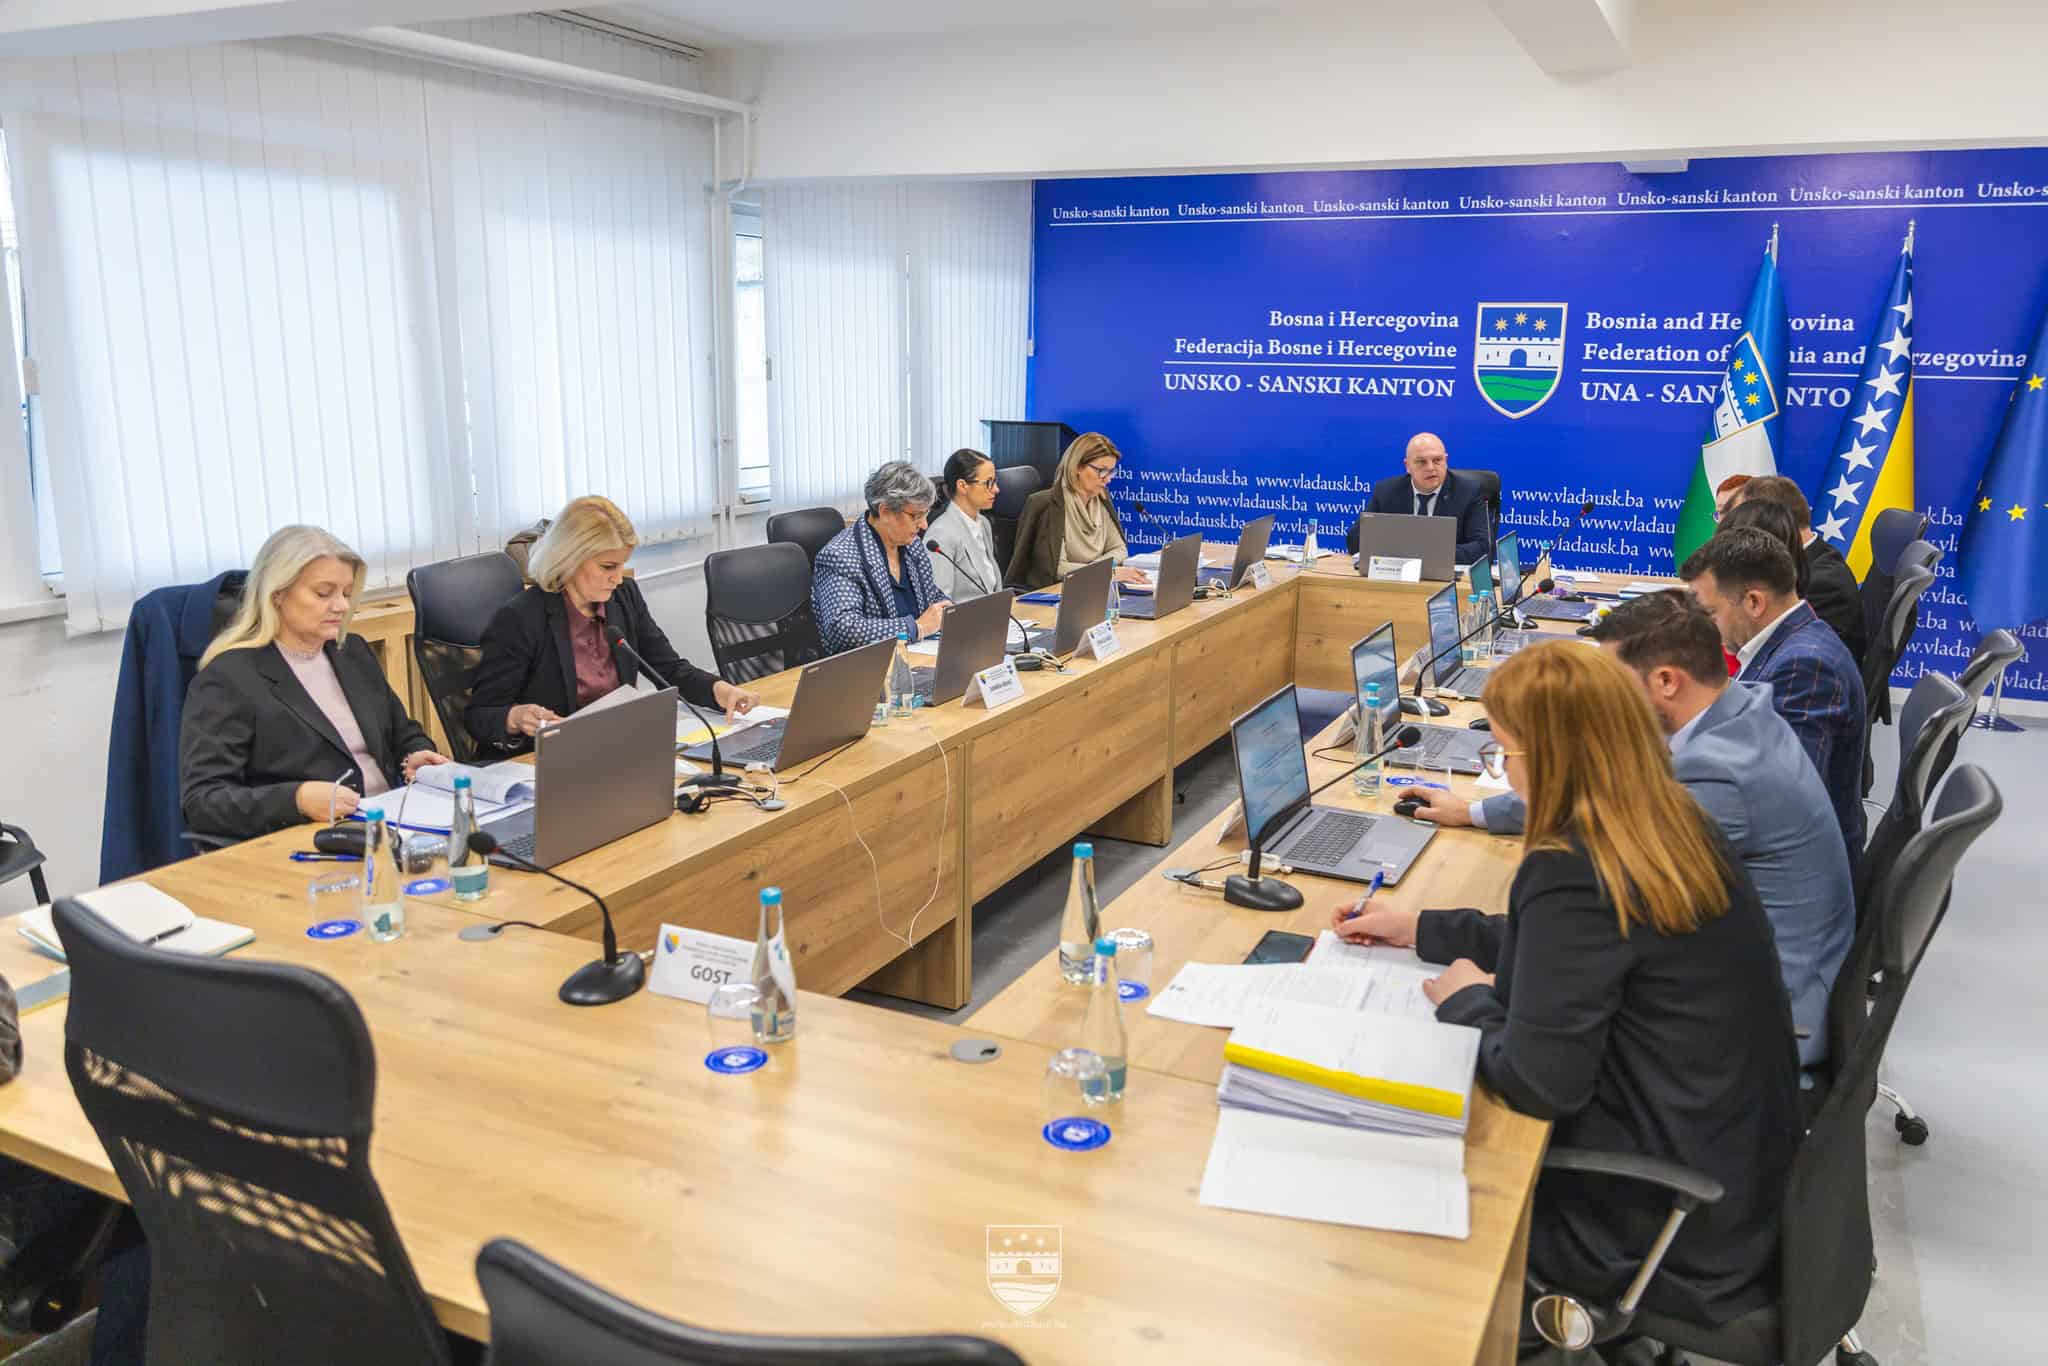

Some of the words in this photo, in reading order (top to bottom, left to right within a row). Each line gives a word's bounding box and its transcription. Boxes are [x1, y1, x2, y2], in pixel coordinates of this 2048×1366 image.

[1052, 205, 1127, 219] Unsko-sanski
[1129, 205, 1169, 217] kanton
[1177, 202, 1257, 216] Unsko-sanski
[1260, 201, 1304, 214] kanton
[1313, 198, 1400, 212] Unsko-sanski
[1403, 198, 1449, 210] kanton
[1459, 194, 1552, 209] Unsko-sanski
[1556, 194, 1607, 207] kanton
[1617, 190, 1719, 206] Unsko-sanski
[1723, 189, 1778, 203] kanton
[1790, 186, 1900, 202] Unsko-sanski
[1903, 184, 1965, 199] kanton
[1977, 181, 2048, 198] Unsko-s
[1269, 310, 1324, 327] Bosna
[1328, 311, 1335, 327] i
[1340, 311, 1459, 333] Hercegovina
[1585, 312, 1657, 330] Bosnia
[1663, 312, 1704, 330] and
[1709, 312, 1855, 331] Heovina
[1175, 337, 1264, 359] Federacija
[1267, 338, 1323, 355] Bosne
[1327, 340, 1333, 356] i
[1338, 340, 1457, 362] Hercegovine
[1583, 343, 1700, 361] Federation
[1705, 344, 1731, 362] of
[1823, 345, 1867, 364] and
[1912, 348, 2027, 372] rzegovina
[1164, 373, 1241, 392] UNSKO
[1258, 375, 1342, 394] SANSKI
[1347, 376, 1456, 397] KANTON
[1580, 382, 1641, 402] UNA
[1660, 383, 1719, 404] SAN
[1785, 386, 1852, 408] NTO
[1140, 467, 1249, 486] www.vladausk.ba
[1256, 473, 1371, 492] www.vladausk.ba
[1196, 492, 1308, 512] www.vladausk.ba
[1511, 486, 1644, 508] www.vladausk.ba
[1580, 514, 1676, 534] www.vladau
[690, 964, 732, 985] GOST
